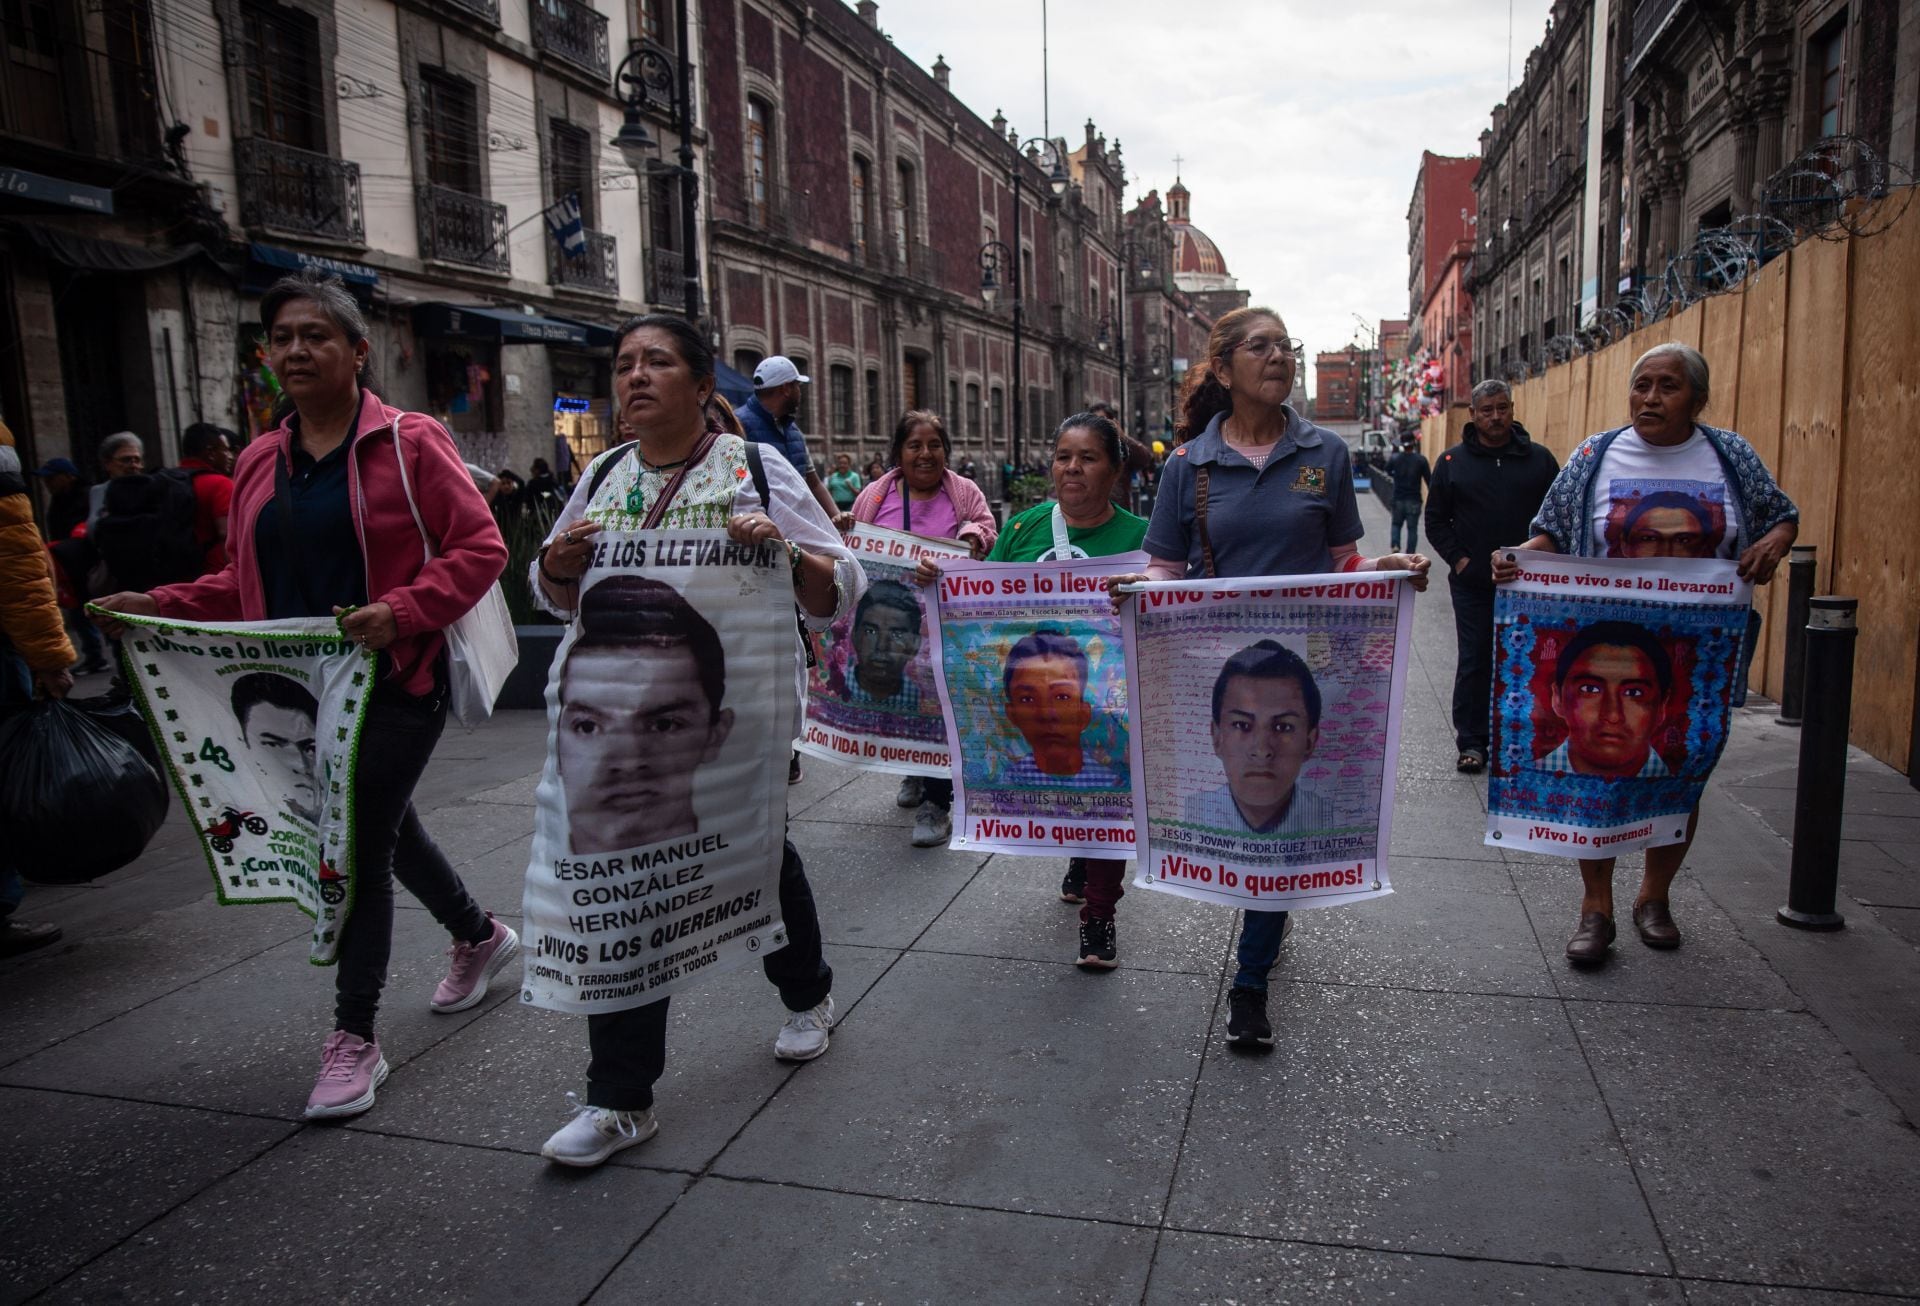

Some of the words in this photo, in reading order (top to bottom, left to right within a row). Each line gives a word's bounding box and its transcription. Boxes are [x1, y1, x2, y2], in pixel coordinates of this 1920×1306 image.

[611, 540, 647, 568] LOS
[654, 539, 777, 569] LLEVARON!
[865, 538, 884, 554] se
[889, 540, 905, 557] lo
[941, 576, 995, 602] ¡Vivo
[1001, 577, 1027, 594] se
[1033, 573, 1054, 594] lo
[1514, 569, 1569, 586] Porque
[1575, 573, 1609, 587] vivo
[1614, 579, 1632, 589] se
[1637, 577, 1654, 590] lo
[1657, 578, 1735, 594] llevaron!
[1065, 608, 1089, 616] quiero
[1140, 591, 1203, 613] ¡Vivo
[150, 635, 205, 656] ¡Vivo
[208, 644, 233, 659] se
[236, 641, 260, 660] lo
[199, 737, 236, 773] 43
[805, 727, 828, 746] ¡Con
[832, 734, 860, 757] VIDA
[863, 741, 877, 758] lo
[880, 745, 952, 768] queremos!
[990, 791, 1015, 804] JOSÉ
[1056, 795, 1084, 807] LUNA
[1091, 796, 1133, 808] TORRES
[270, 830, 307, 848] JORGE
[976, 818, 1022, 841] ¡Vivo
[1028, 821, 1046, 840] lo
[1161, 829, 1192, 842] JESÚS
[1199, 835, 1236, 850] JOVANY
[1243, 840, 1306, 854] RODRÍGUEZ
[1311, 837, 1364, 850] TLATEMPA
[1528, 826, 1568, 842] ¡Vivo
[1573, 832, 1588, 845] lo
[1592, 824, 1653, 848] queremos!
[241, 856, 280, 876] ¡Con
[280, 858, 307, 879] VIDA
[554, 858, 624, 881] CÉSAR
[631, 834, 729, 872] MANUEL
[572, 863, 705, 907] GONZÁLEZ
[1160, 854, 1212, 883] ¡Vivo
[1218, 864, 1239, 888] lo
[1244, 863, 1363, 897] queremos!
[568, 884, 714, 934] HERNÁNDEZ
[536, 934, 589, 965] ¡VIVOS
[599, 935, 642, 963] LOS
[650, 889, 761, 949] QUEREMOS!
[565, 974, 574, 986] EL
[578, 968, 644, 986] TERRORISMO
[647, 961, 660, 974] DE
[663, 945, 700, 968] ESTADO,
[703, 939, 715, 951] LA
[716, 914, 771, 946] SOLIDARIDAD
[579, 983, 646, 1001] AYOTZINAPA
[648, 968, 680, 990] SOMXS
[682, 951, 719, 975] TODOXS
